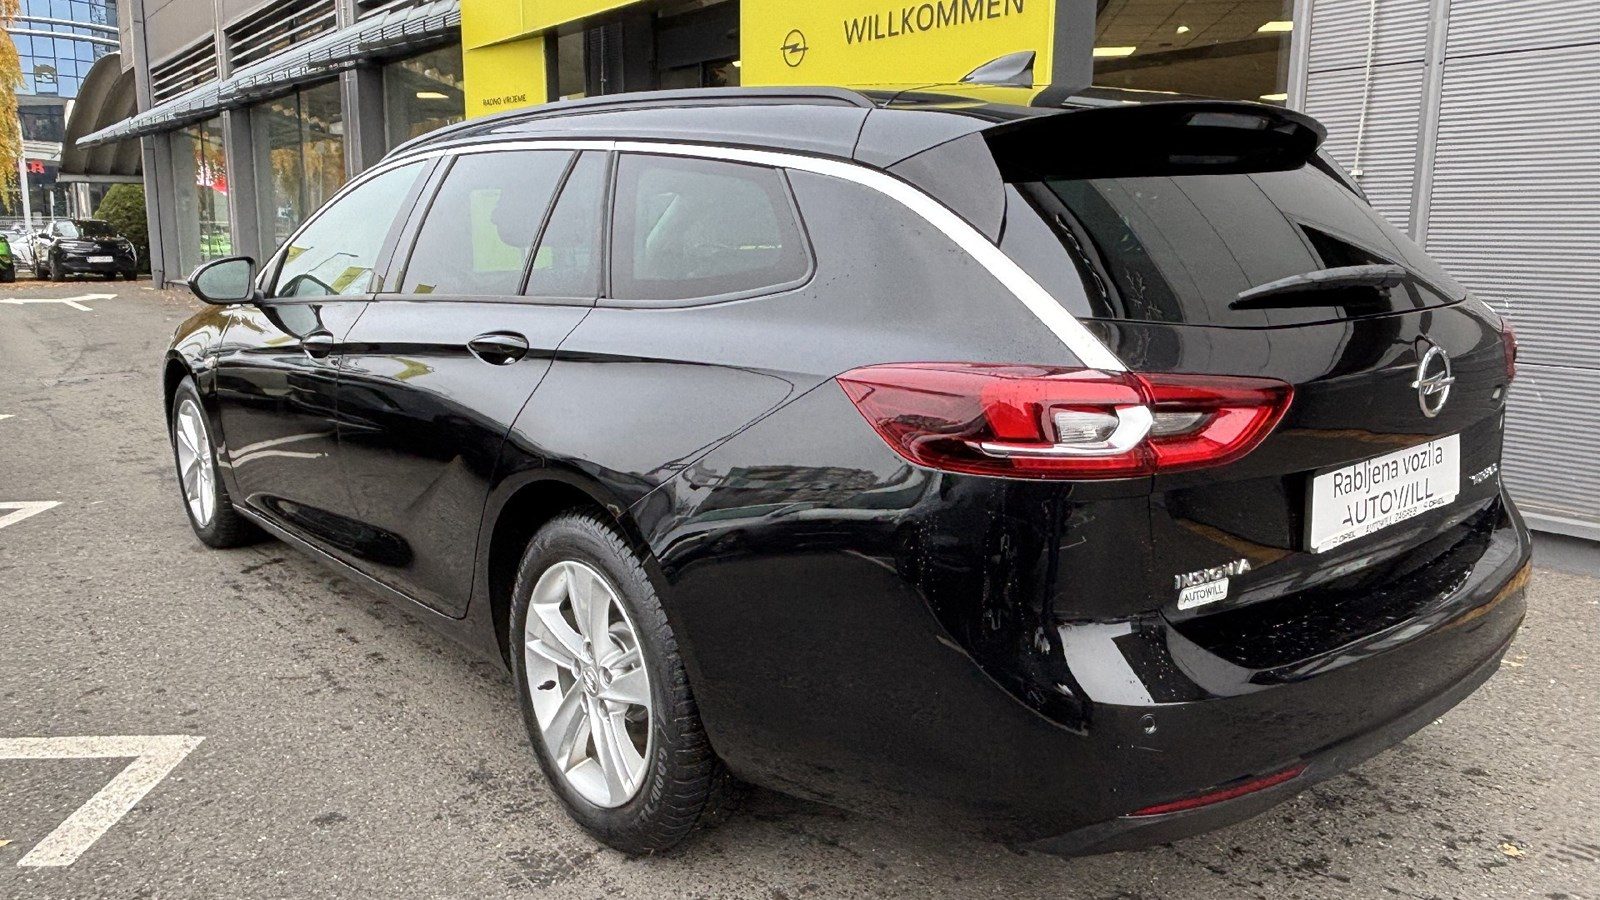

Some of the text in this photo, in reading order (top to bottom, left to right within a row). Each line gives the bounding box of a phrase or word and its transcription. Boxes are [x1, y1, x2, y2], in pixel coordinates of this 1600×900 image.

[844, 0, 1025, 45] WILLKOMMEN
[1333, 460, 1399, 498] Rabljena
[1403, 442, 1443, 475] vozila
[1174, 559, 1251, 590] INSIGNIA
[1183, 584, 1224, 603] AUTOWILL
